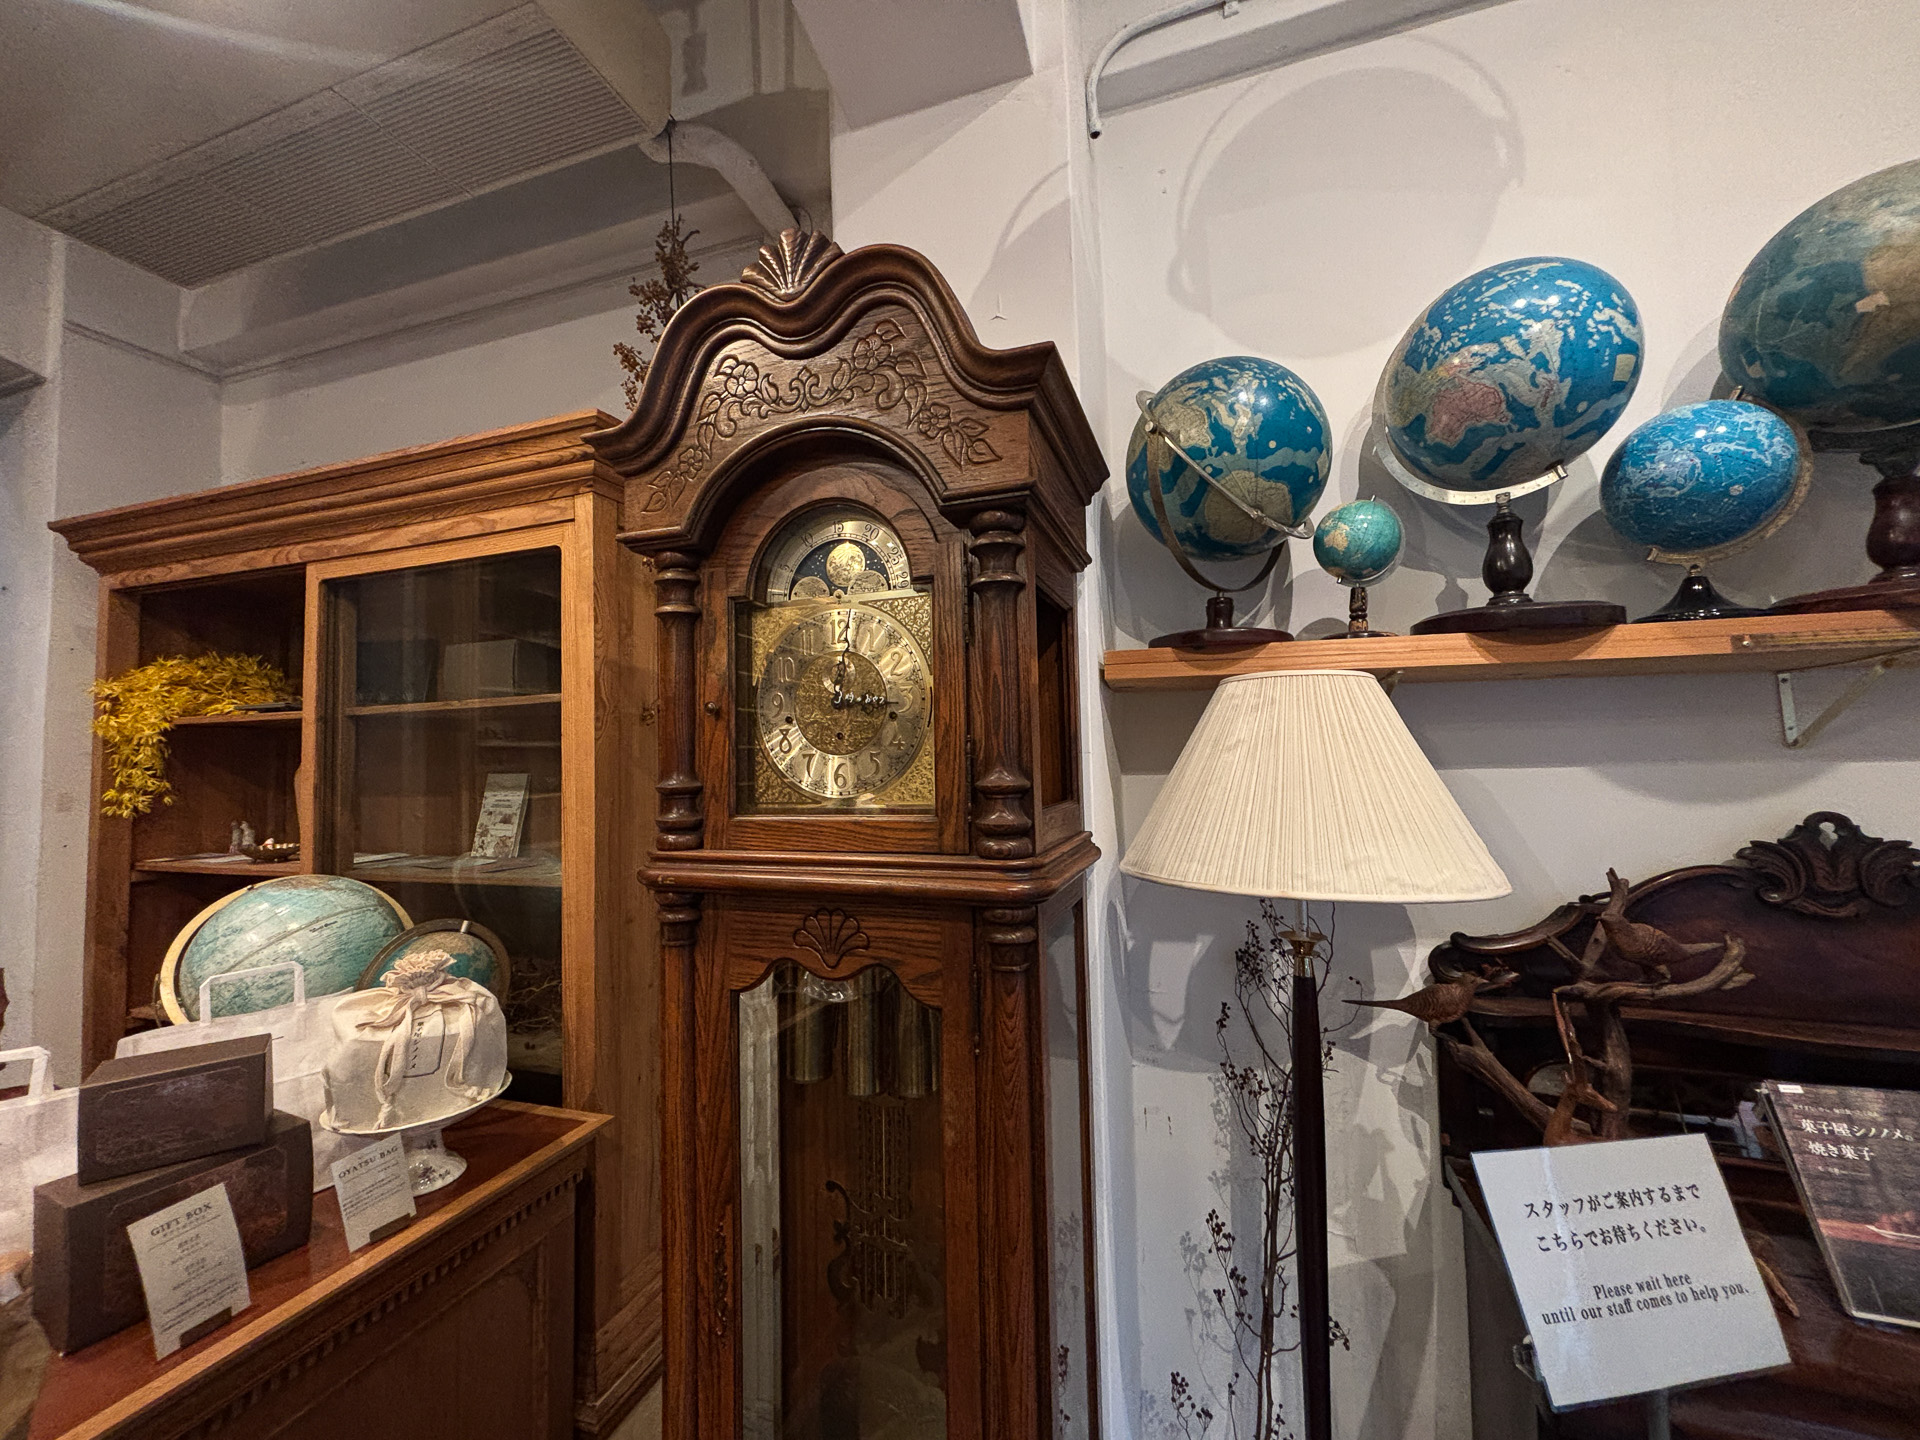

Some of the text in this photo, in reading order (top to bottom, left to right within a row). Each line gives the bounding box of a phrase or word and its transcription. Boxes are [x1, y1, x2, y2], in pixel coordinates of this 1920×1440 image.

[801, 532, 814, 547] 10
[832, 521, 844, 534] 15
[862, 523, 880, 540] 20
[888, 547, 903, 565] 25
[896, 571, 909, 588] 29
[801, 629, 814, 656] 11
[831, 619, 849, 645] 12
[778, 656, 796, 683] 10
[890, 651, 904, 677] 2
[771, 691, 785, 718] 9
[898, 686, 914, 713] 3
[779, 728, 793, 754] 8
[802, 753, 816, 778] 7
[833, 763, 848, 789] 6
[865, 750, 881, 778] 5
[338, 1156, 376, 1179] OYATSU
[379, 1146, 399, 1159] BAG
[1806, 1139, 1875, 1162] 焼き菓子
[1524, 1183, 1700, 1219] スタッフがご案内するまで
[150, 1216, 182, 1237] GIFT
[185, 1202, 213, 1220] BOX
[1536, 1216, 1708, 1252] こちらでお待ちください。
[1593, 1272, 1692, 1300] Please wait here
[1541, 1283, 1750, 1326] until our staff comes to help you.
